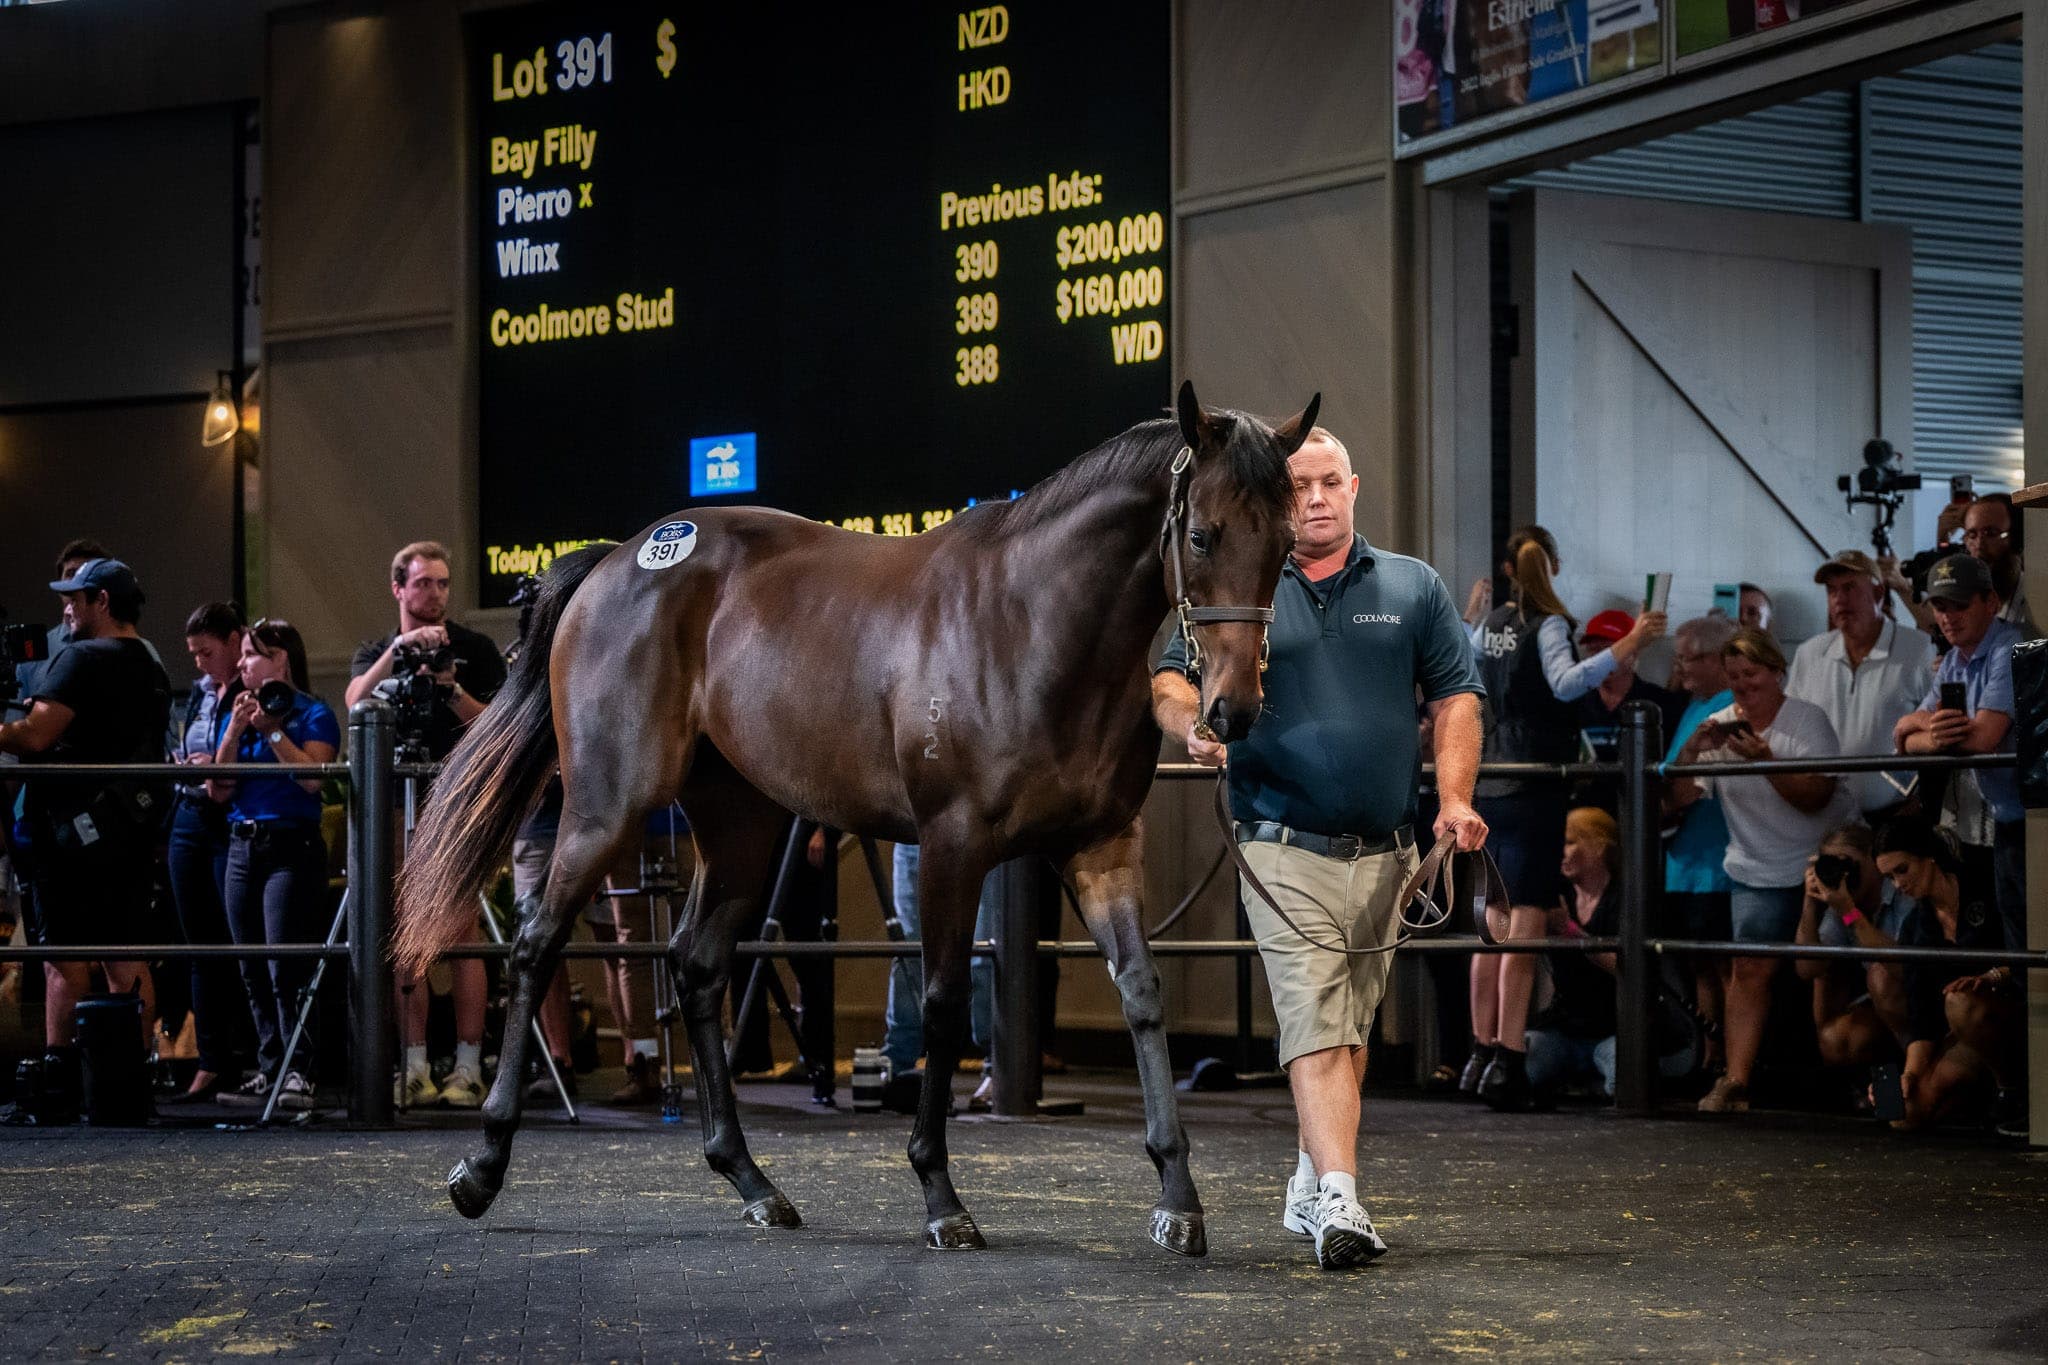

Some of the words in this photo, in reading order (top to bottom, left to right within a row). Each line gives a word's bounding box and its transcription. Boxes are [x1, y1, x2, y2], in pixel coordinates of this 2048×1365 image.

[959, 6, 1008, 50] NZD
[494, 47, 547, 101] Lot
[557, 33, 611, 90] 391
[657, 20, 676, 78] $
[959, 66, 1010, 111] HKD
[492, 137, 539, 179] Bay
[544, 125, 596, 169] Filly
[498, 186, 572, 226] Pierro
[579, 183, 593, 208] x
[941, 183, 1044, 230] Previous
[1049, 170, 1102, 211] lots:
[496, 238, 560, 278] Winx
[956, 240, 998, 283] 390
[1056, 212, 1163, 270] $200,000
[491, 304, 610, 346] Coolmore
[616, 288, 673, 332] Stud
[956, 292, 998, 334] 389
[1056, 266, 1163, 323] $160,000
[956, 344, 999, 386] 388
[1111, 320, 1163, 365] W/D
[487, 543, 553, 579] Today's
[647, 543, 679, 563] 391
[1353, 614, 1402, 625] COOLMORE
